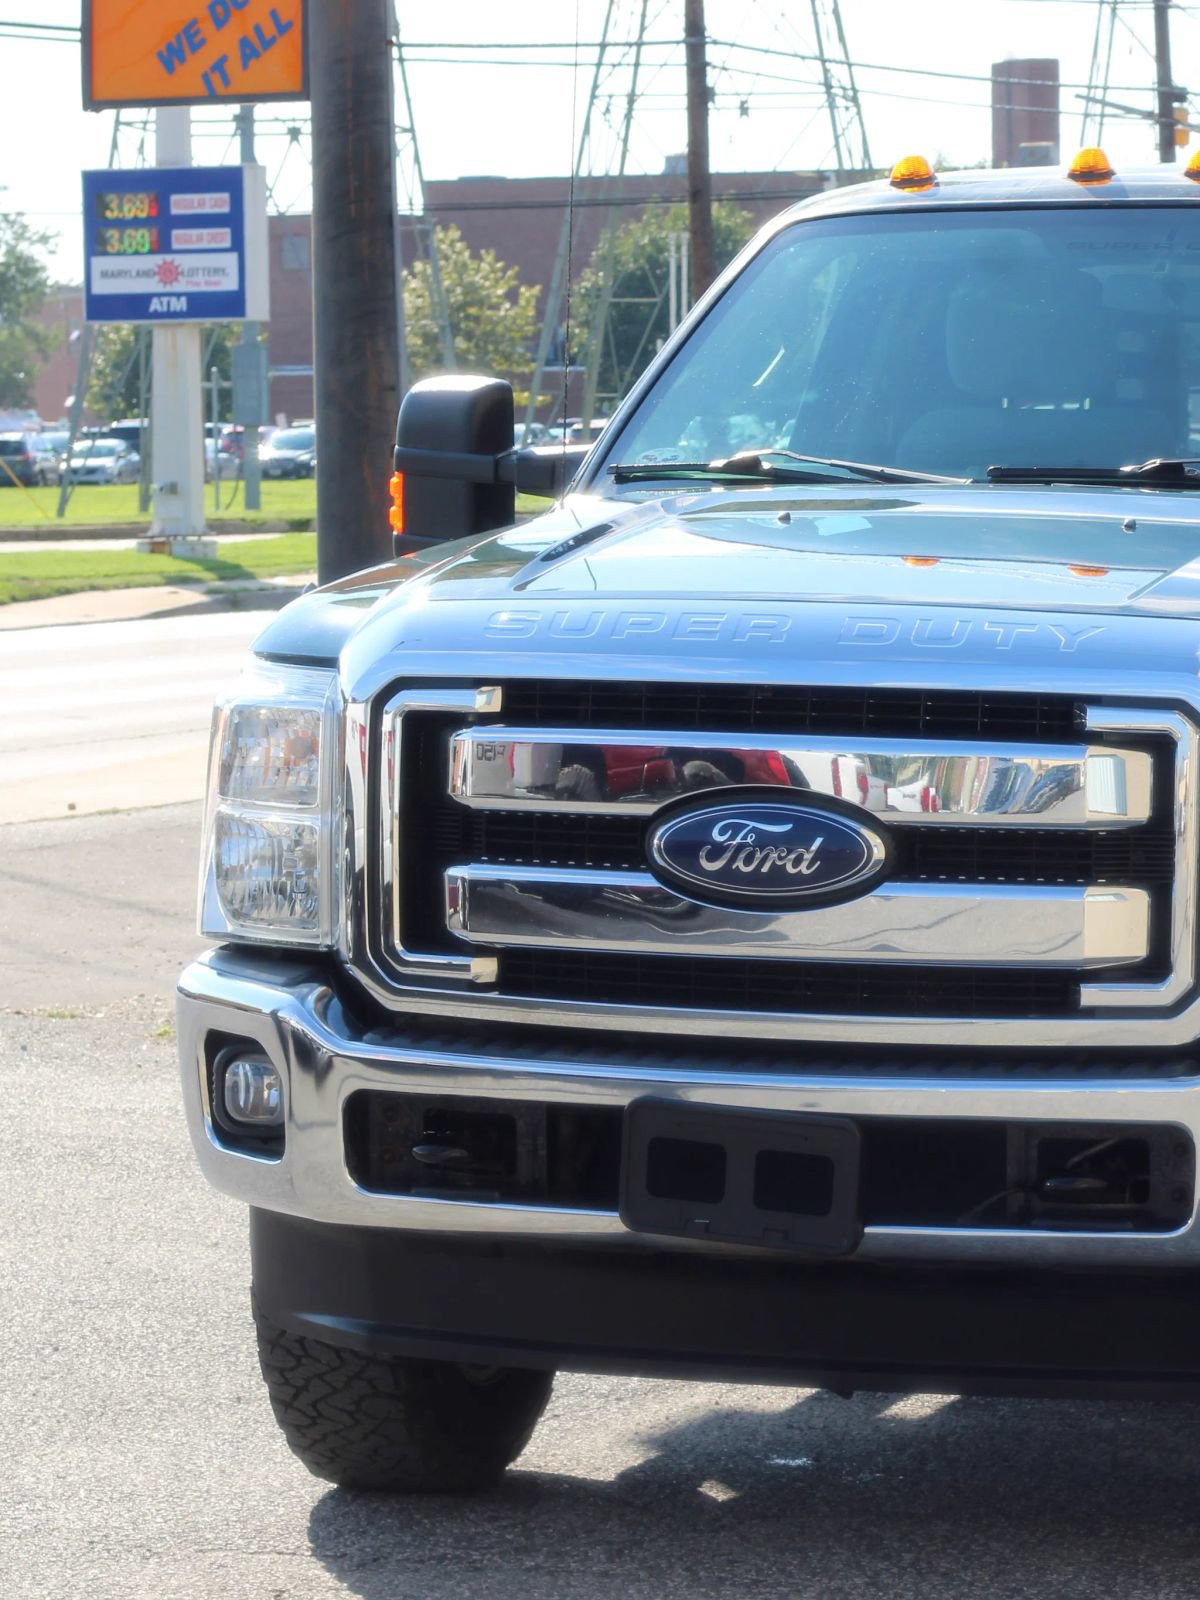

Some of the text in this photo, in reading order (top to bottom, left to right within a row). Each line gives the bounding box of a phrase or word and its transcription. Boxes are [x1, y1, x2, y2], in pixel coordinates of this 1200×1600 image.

[156, 18, 206, 76] WE
[202, 8, 293, 96] IT ALL
[100, 268, 155, 280] MARYLAND
[149, 295, 188, 313] ATM
[484, 609, 1107, 652] SUPER DUTY
[699, 817, 825, 877] Ford
